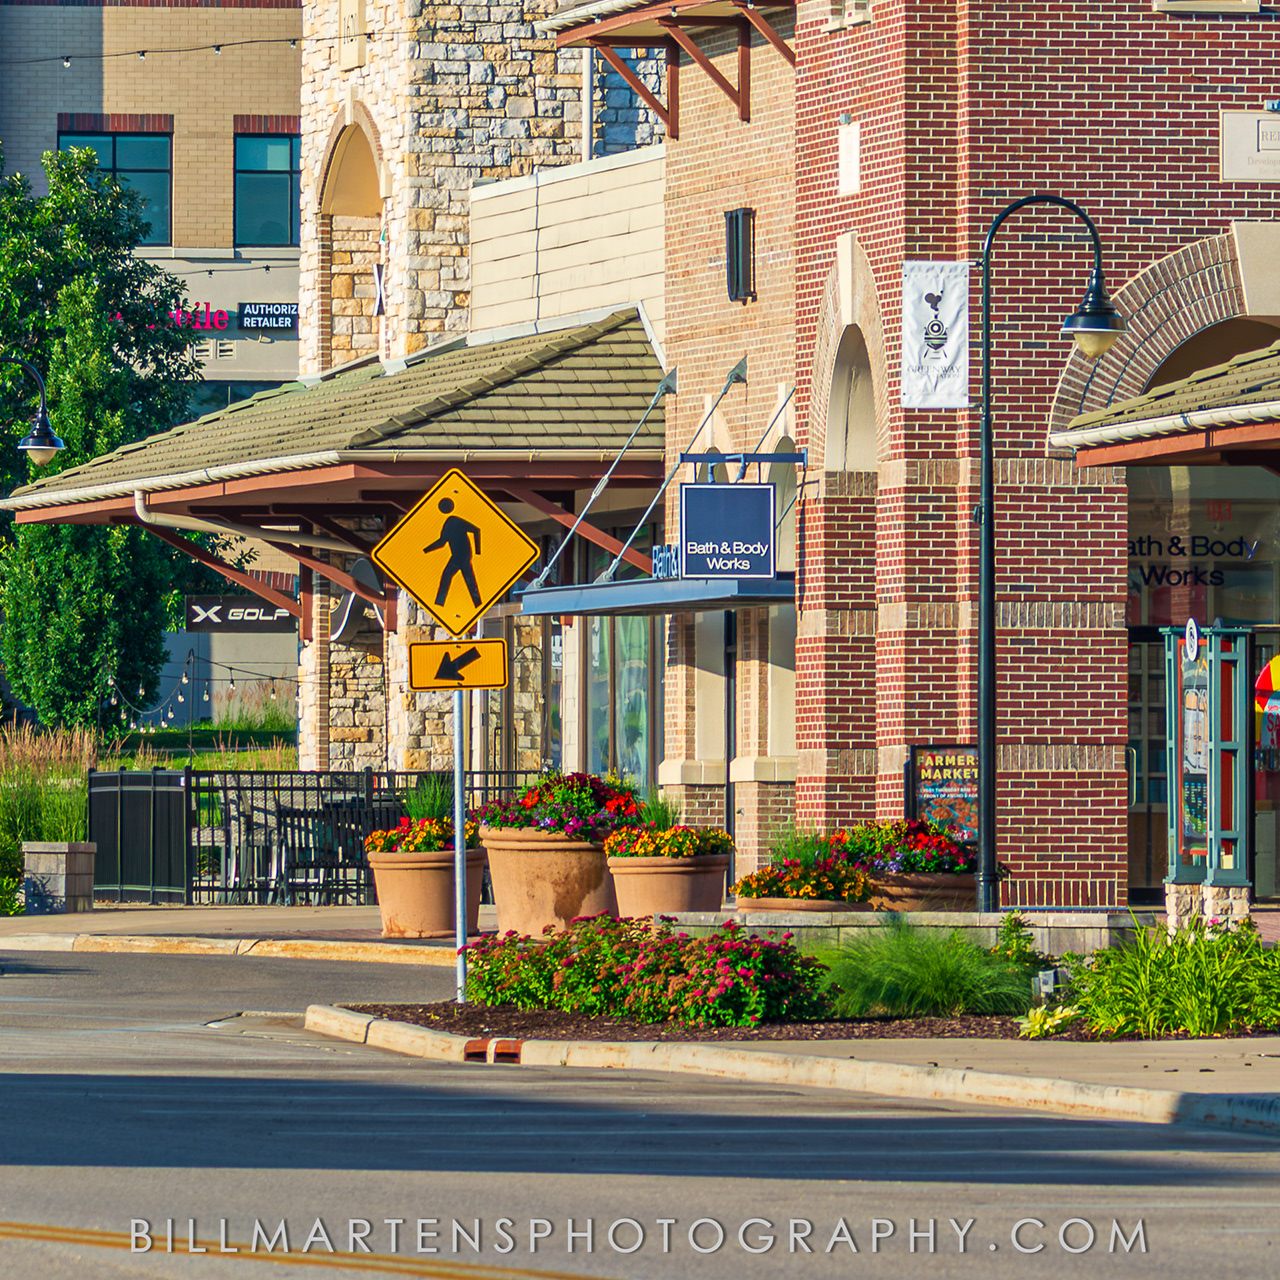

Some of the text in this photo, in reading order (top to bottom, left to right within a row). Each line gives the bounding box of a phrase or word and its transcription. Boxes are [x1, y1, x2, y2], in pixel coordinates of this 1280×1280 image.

[243, 304, 298, 315] AUTHORIZ
[243, 317, 292, 328] RETAILER
[687, 542, 769, 557] Bath & Body
[1128, 535, 1260, 560] ath & Body
[652, 545, 671, 578] Bath
[706, 558, 751, 570] Works
[1139, 565, 1224, 586] Works
[192, 605, 290, 622] X GOLF
[917, 755, 978, 767] FARMER
